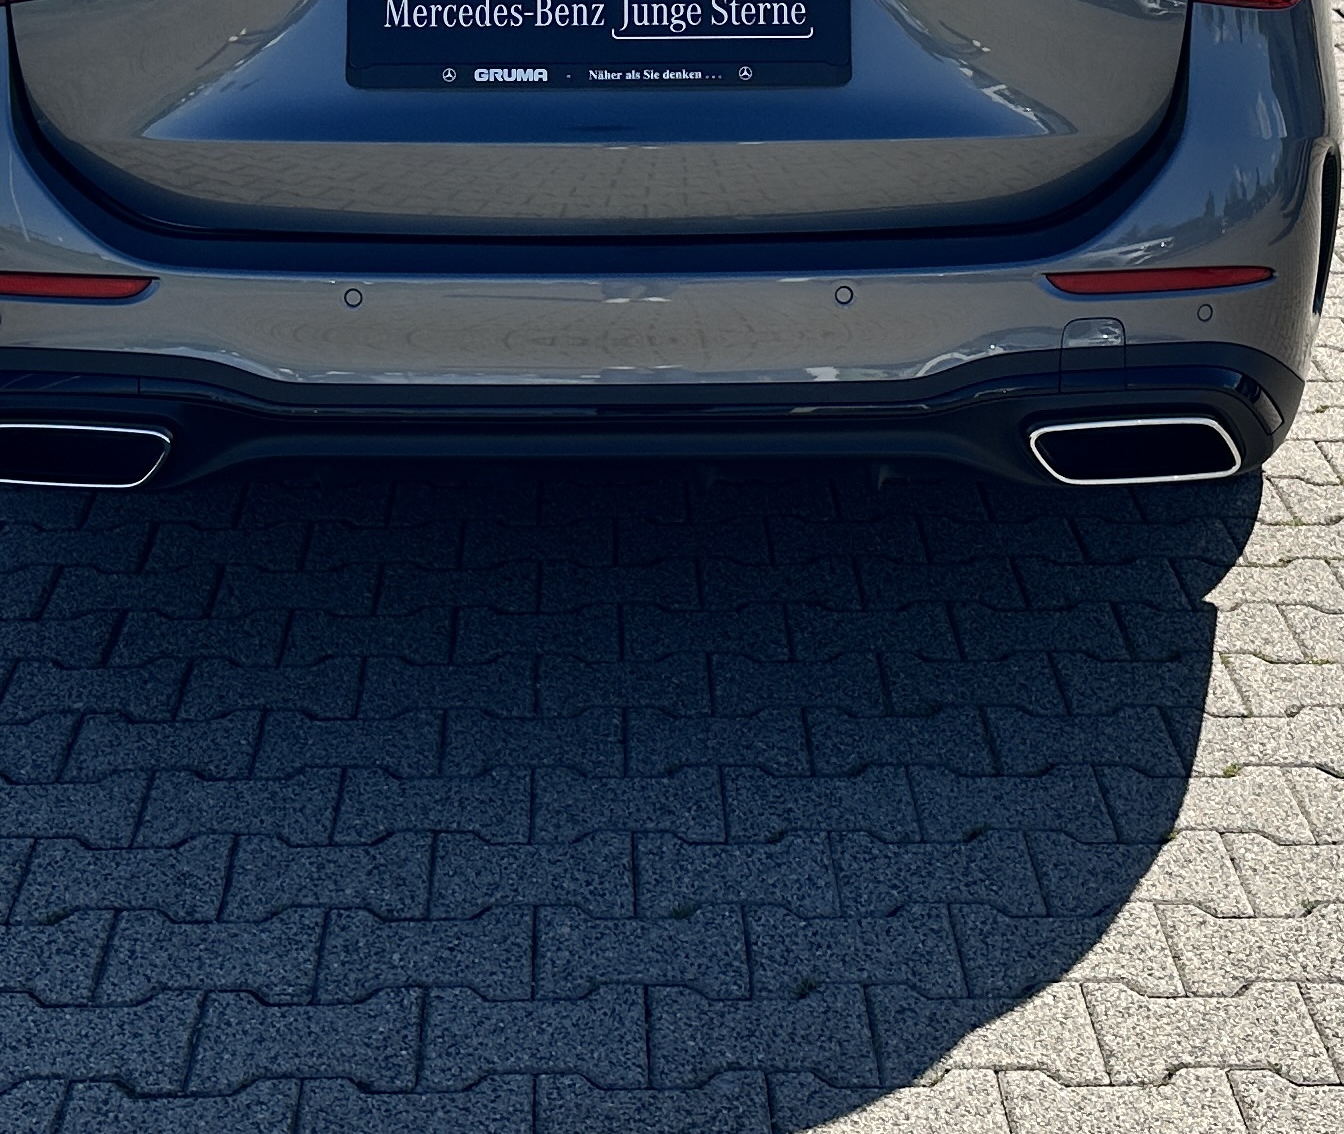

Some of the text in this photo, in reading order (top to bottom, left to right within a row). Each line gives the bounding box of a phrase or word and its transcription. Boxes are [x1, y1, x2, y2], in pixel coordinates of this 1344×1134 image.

[474, 68, 548, 82] GRUMA
[588, 69, 622, 80] Näher
[625, 69, 641, 80] als
[643, 69, 660, 80] Sie
[662, 69, 702, 80] denken
